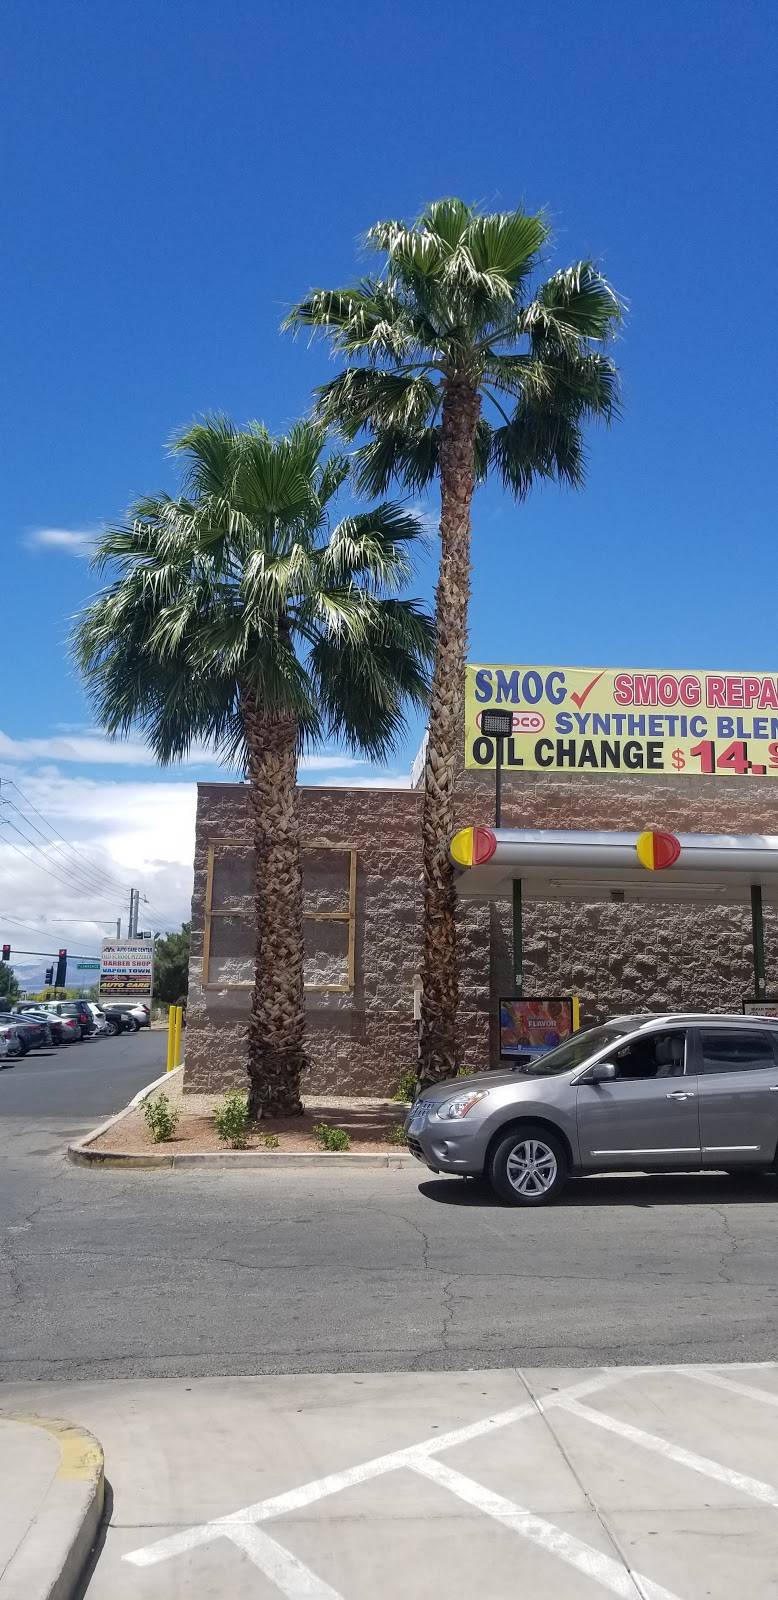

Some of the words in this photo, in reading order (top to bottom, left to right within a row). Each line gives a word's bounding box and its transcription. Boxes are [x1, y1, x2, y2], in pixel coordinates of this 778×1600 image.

[474, 669, 567, 704] SMOG
[613, 674, 701, 707] SMOG
[554, 711, 708, 737] SYNTHETIC
[472, 736, 524, 765] OIL
[534, 738, 664, 769] CHANGE
